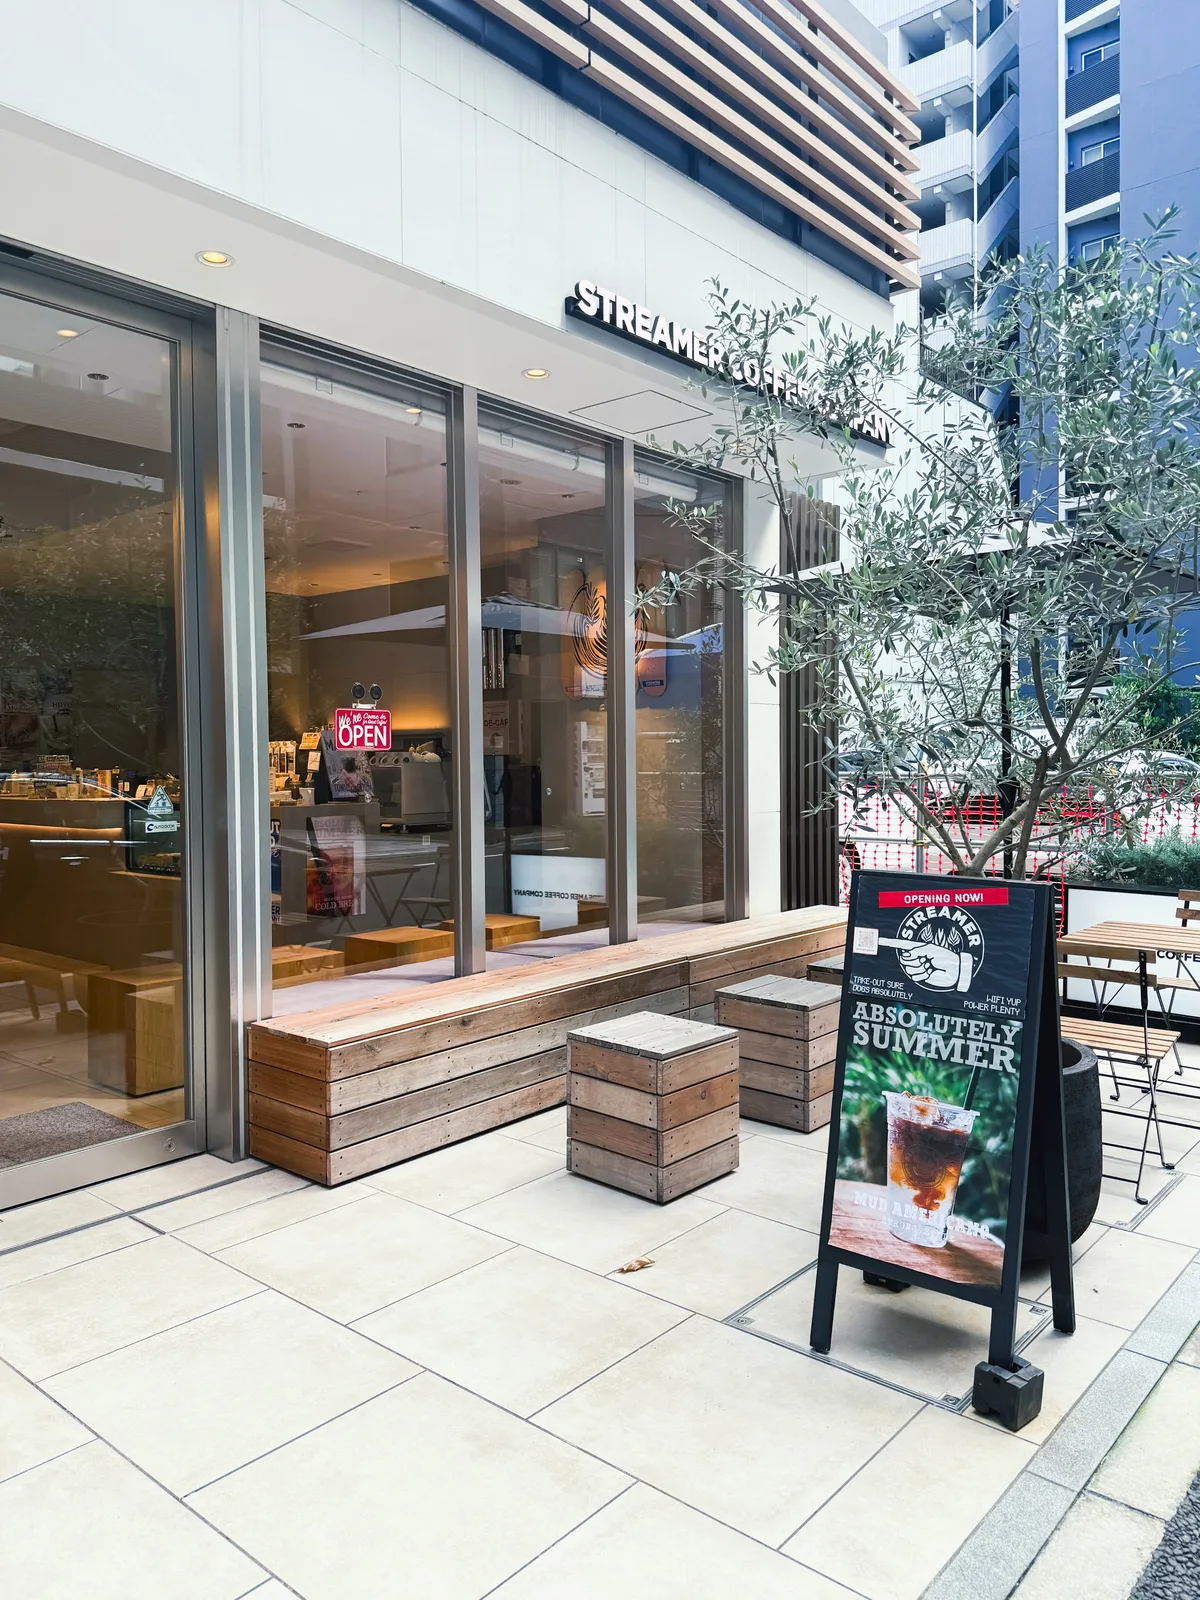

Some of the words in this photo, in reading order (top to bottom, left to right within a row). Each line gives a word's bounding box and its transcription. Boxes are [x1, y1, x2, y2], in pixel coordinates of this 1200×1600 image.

[576, 279, 727, 373] STREAMER
[338, 724, 387, 747] OPEN
[315, 902, 337, 911] COLD
[904, 894, 950, 904] OPENING
[955, 893, 984, 903] NOW!
[901, 905, 982, 948] STREAMER
[852, 984, 870, 993] DOGS
[870, 987, 913, 1000] ABSOLUTELY
[853, 975, 886, 987] TAKE-OUT
[886, 980, 905, 990] SURE
[963, 1000, 989, 1011] POWER
[990, 1004, 1021, 1016] PLENTY
[986, 994, 1004, 1005] WIFI
[1006, 997, 1022, 1006] YUP
[852, 1001, 1020, 1046] ABSOLUTELY
[852, 1021, 1017, 1074] SUMMER
[853, 1190, 888, 1213] MUD
